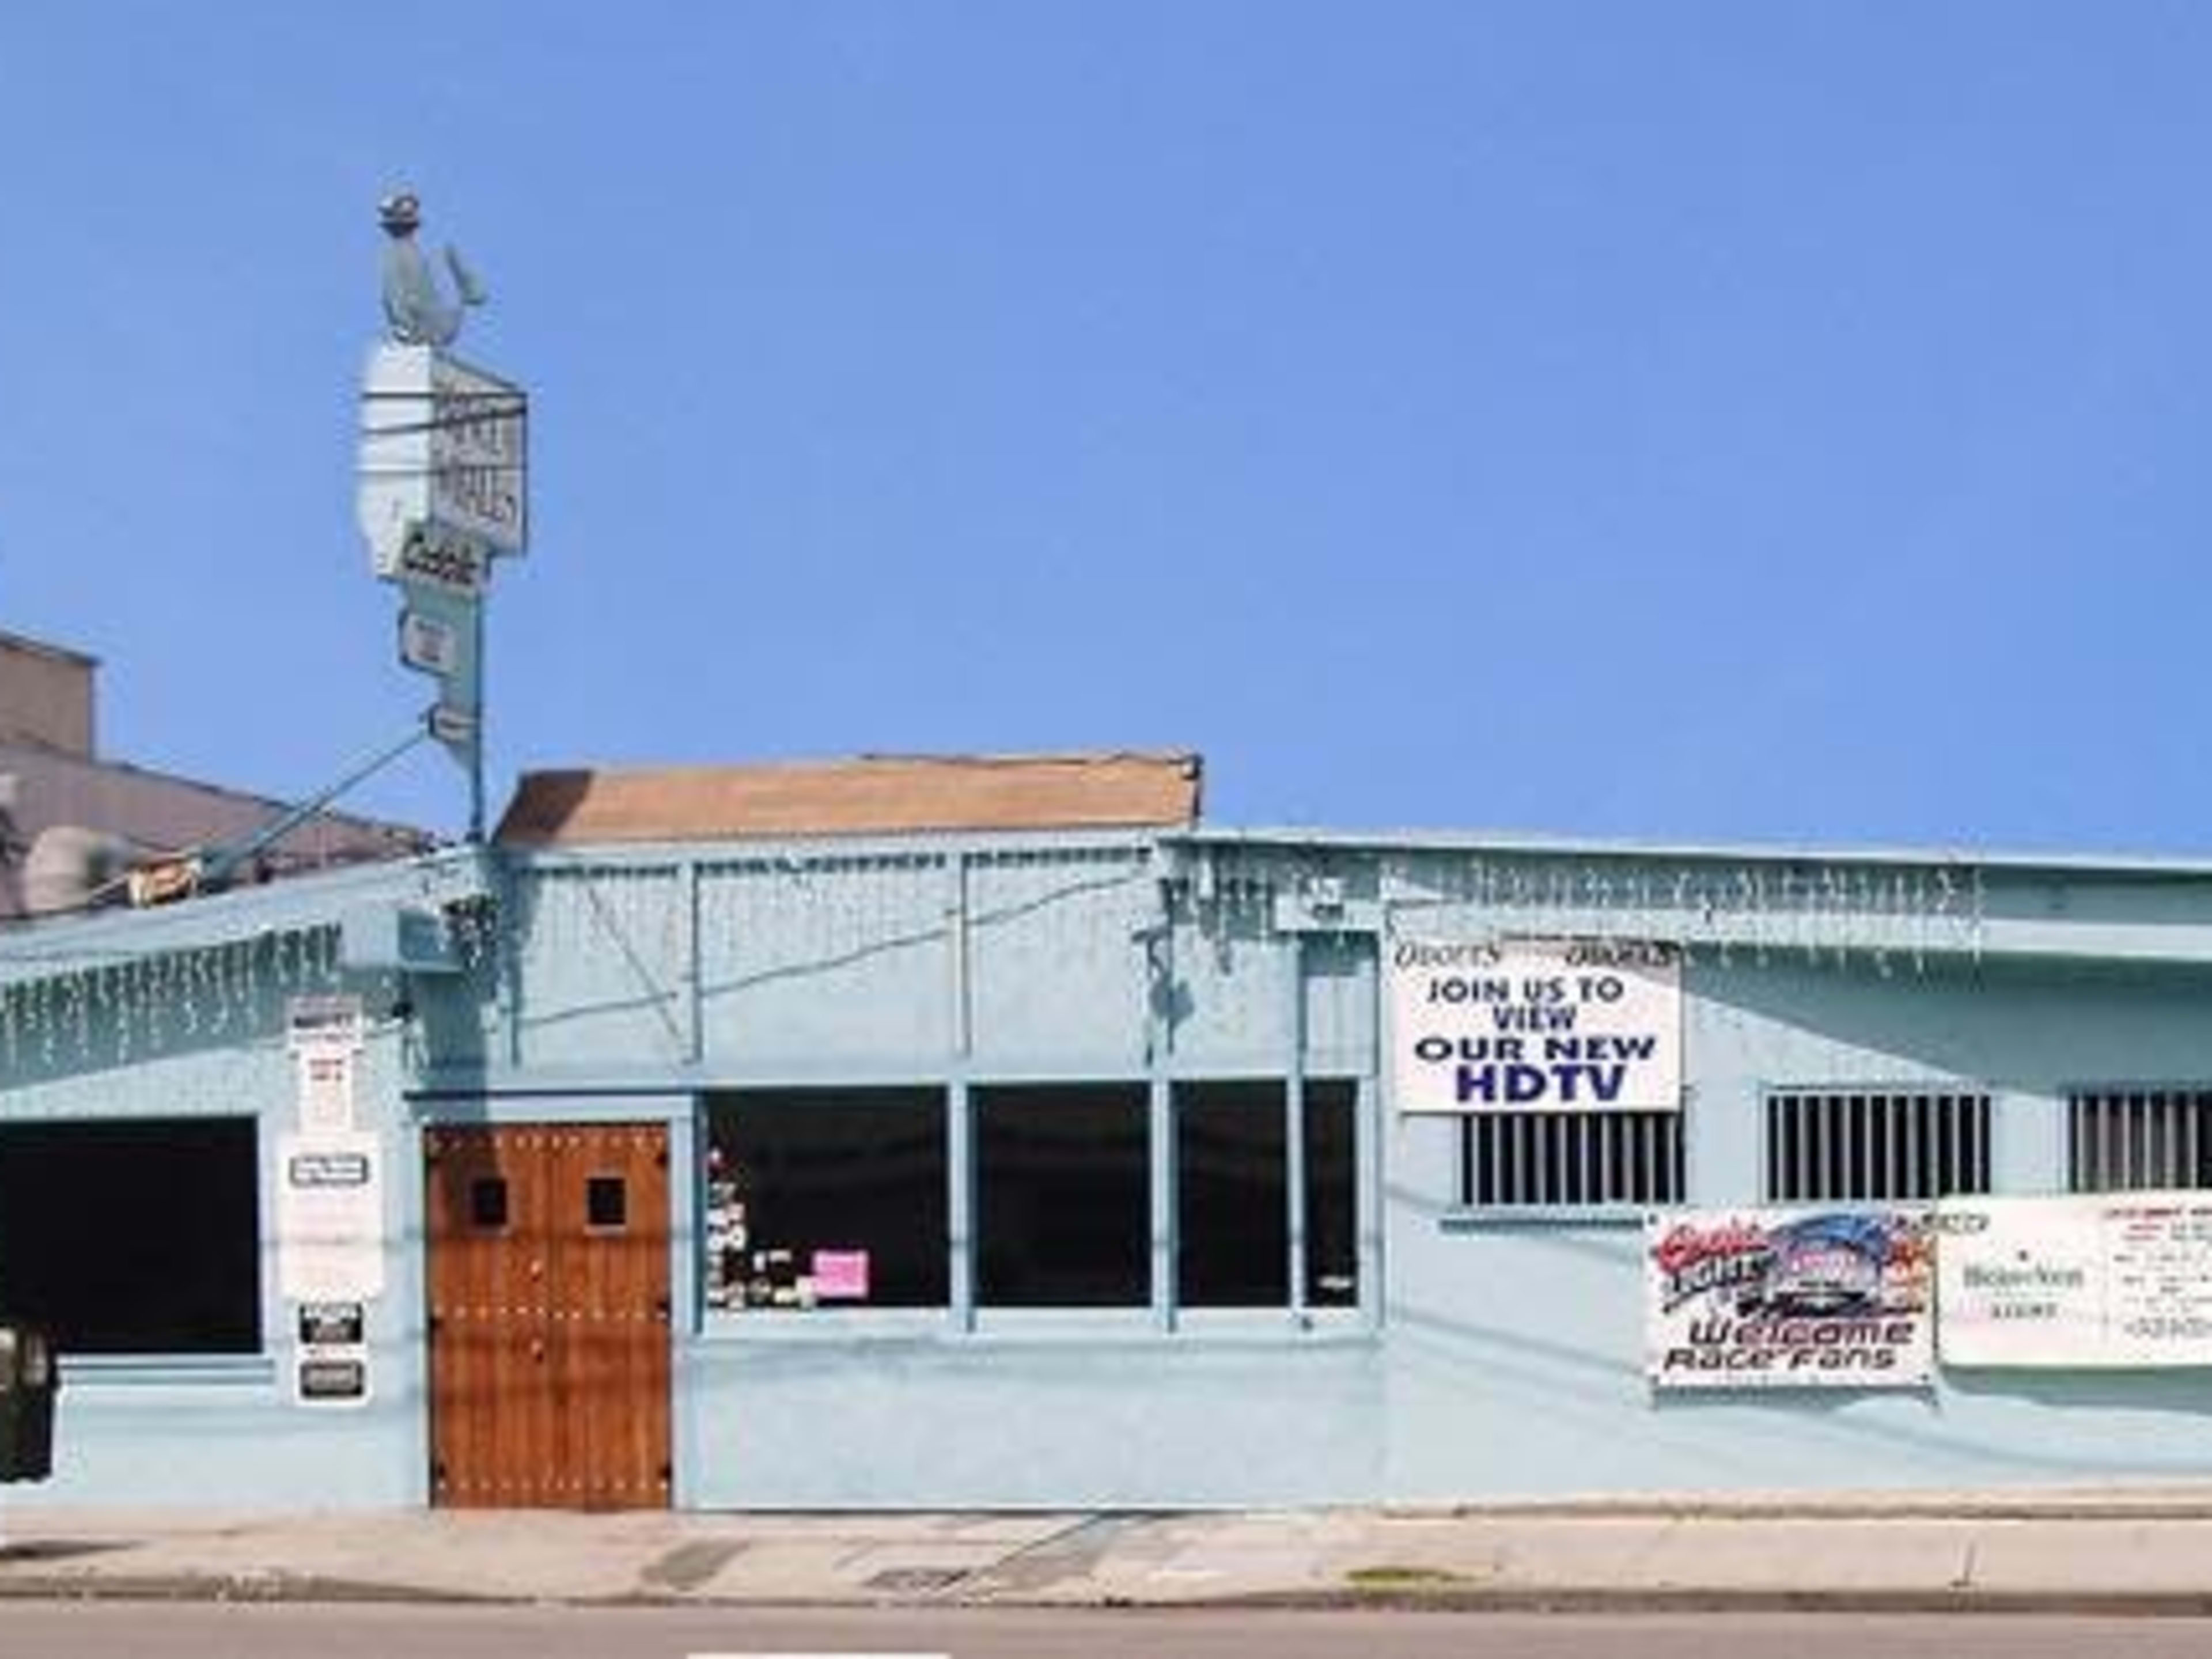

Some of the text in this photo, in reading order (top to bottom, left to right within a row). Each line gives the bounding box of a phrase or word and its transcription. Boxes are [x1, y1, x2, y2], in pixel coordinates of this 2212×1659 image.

[1428, 976, 1623, 1002] JOIN US TO
[1493, 1005, 1577, 1030] VIEW
[1415, 1036, 1656, 1060] OUR NEW
[1455, 1064, 1627, 1101] HDTV
[1689, 1321, 1915, 1344] Welcome
[1664, 1348, 1896, 1370] Race Fans
